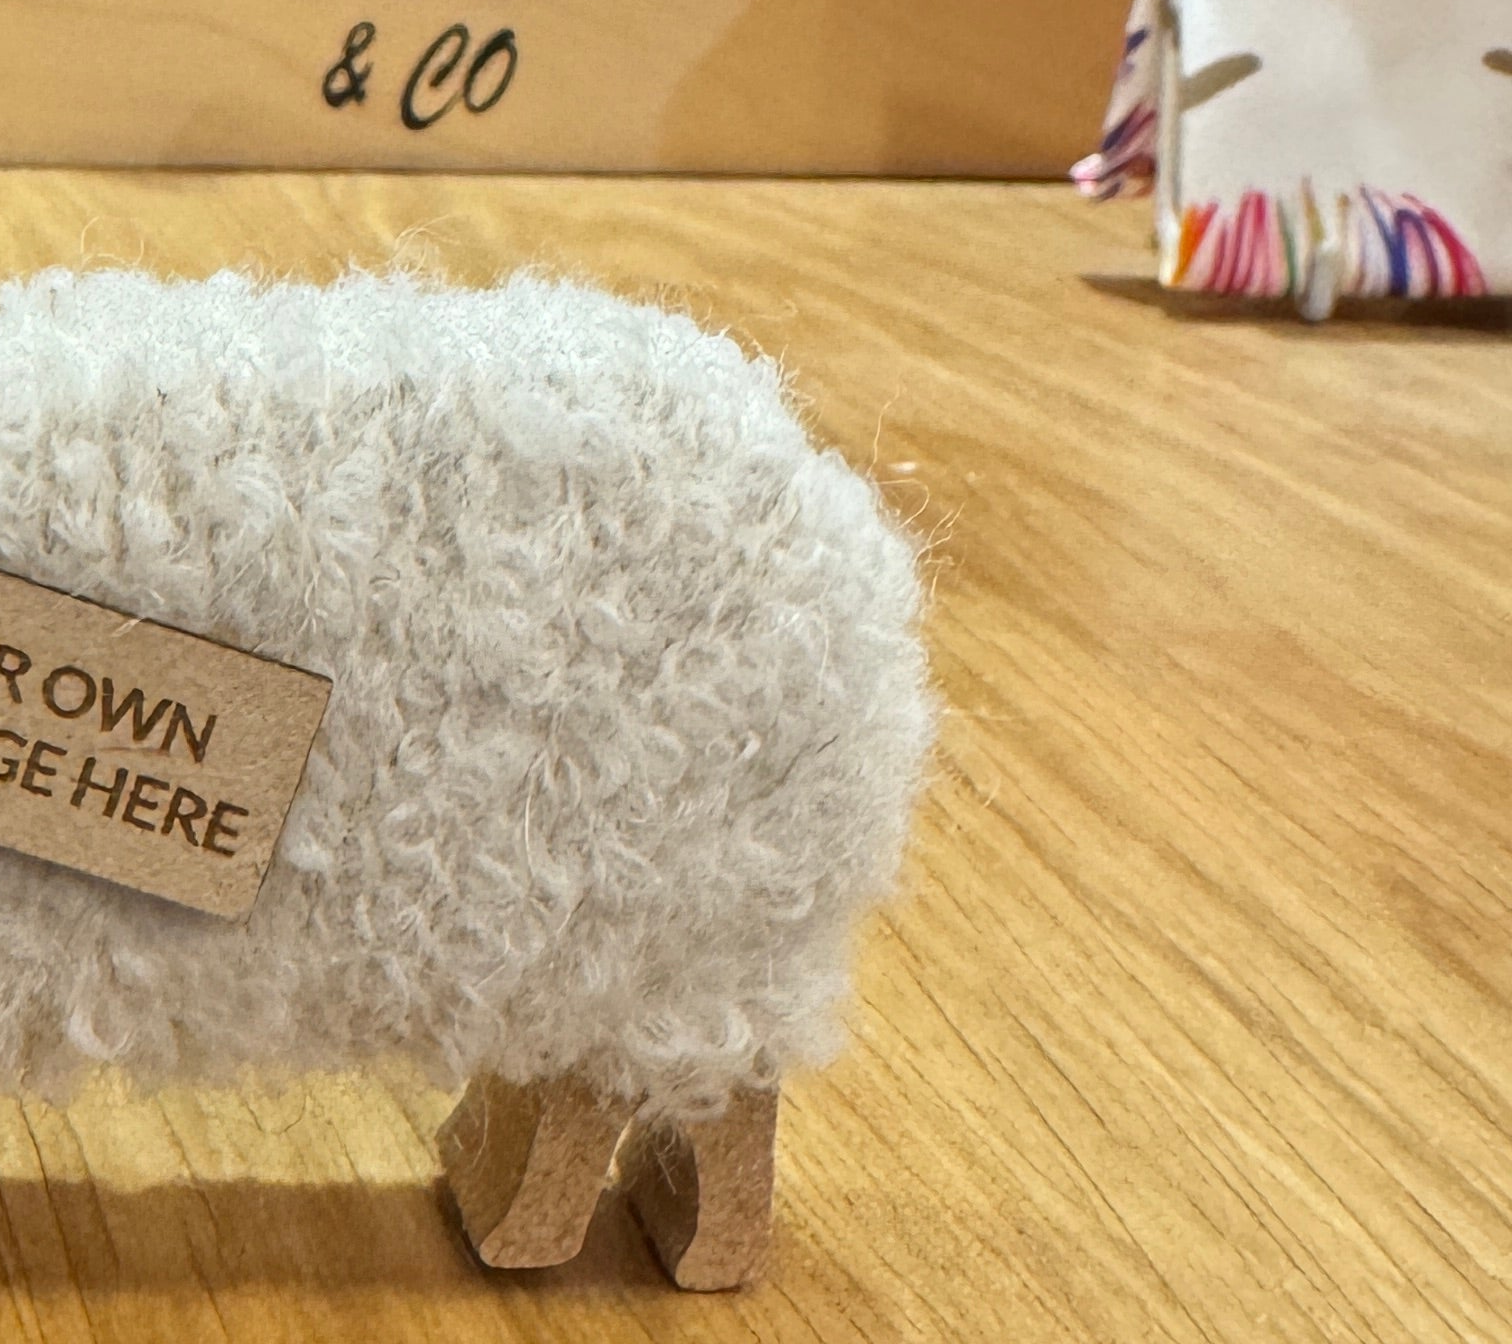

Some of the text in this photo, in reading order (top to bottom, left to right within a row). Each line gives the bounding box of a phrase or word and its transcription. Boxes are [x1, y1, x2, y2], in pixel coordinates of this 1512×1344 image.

[322, 21, 518, 130] & CO
[42, 665, 217, 765] OWN
[69, 756, 249, 857] HERE
